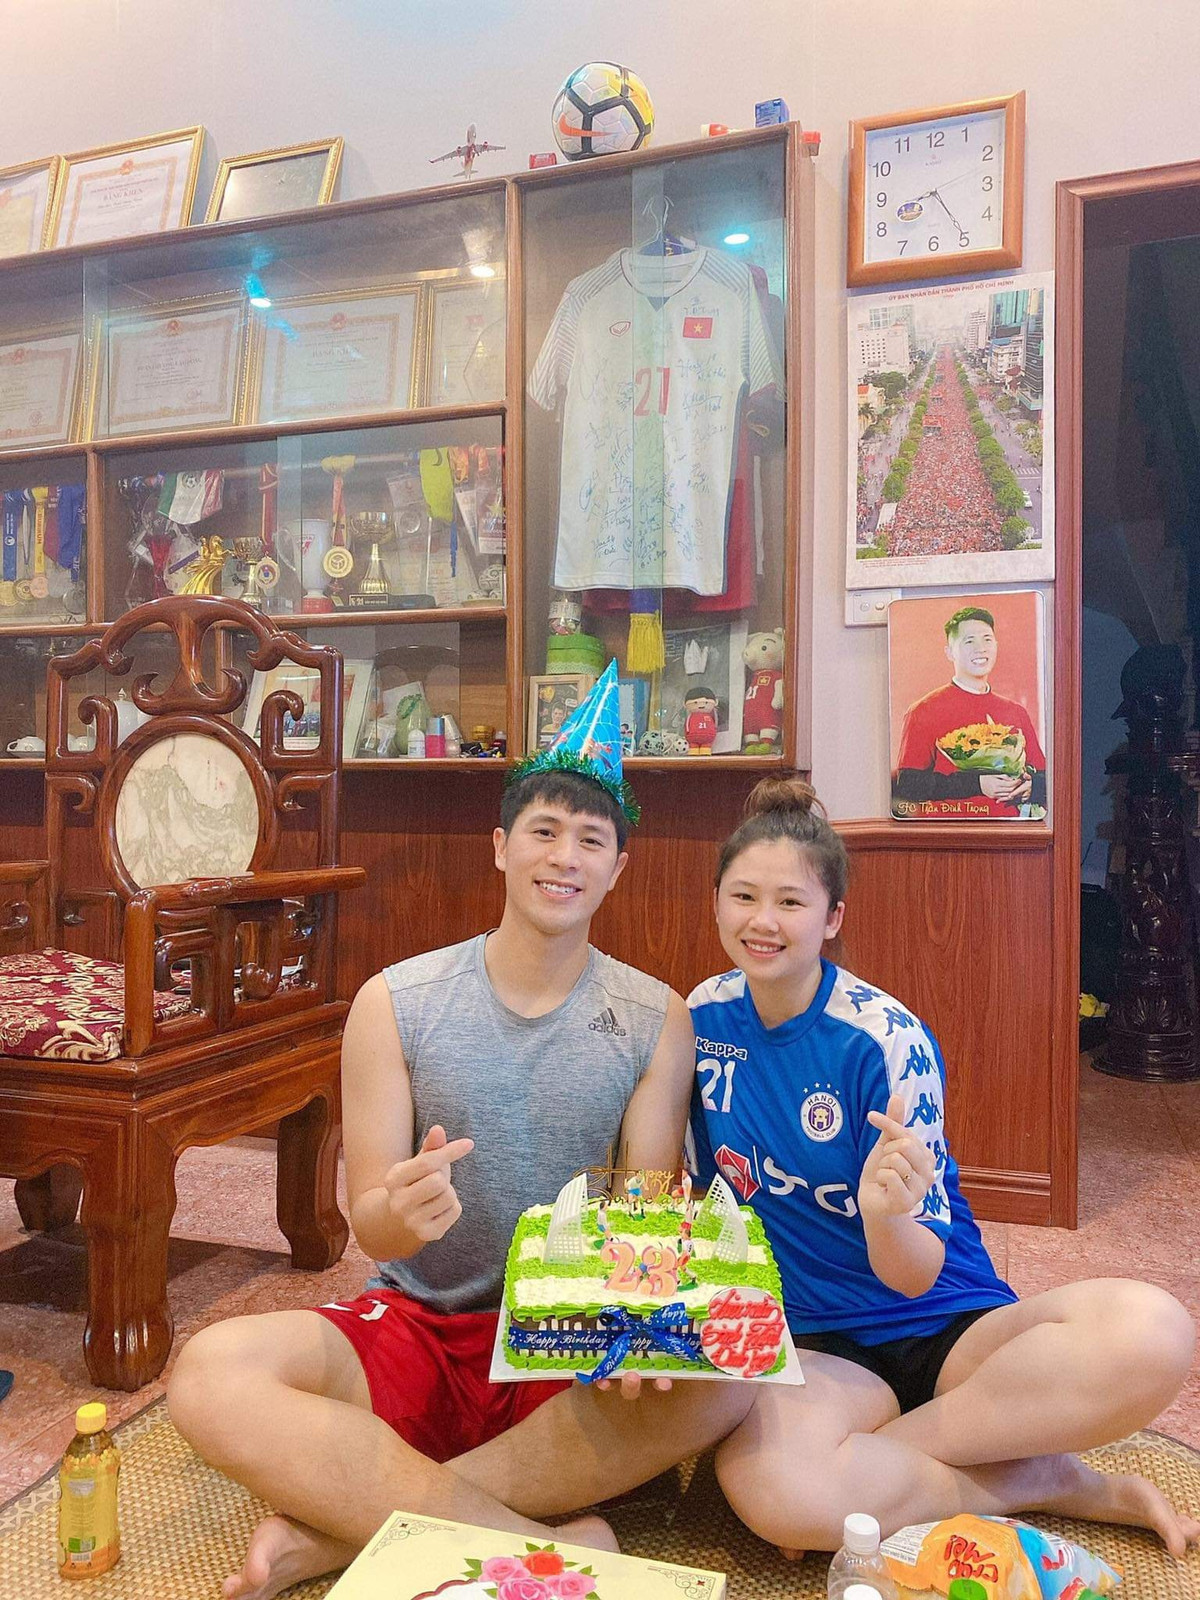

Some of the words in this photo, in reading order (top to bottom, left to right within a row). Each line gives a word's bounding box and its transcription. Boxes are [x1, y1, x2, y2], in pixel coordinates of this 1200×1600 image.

[926, 131, 945, 149] 12
[961, 126, 968, 143] 1
[895, 136, 911, 154] 11
[982, 145, 994, 162] 2
[872, 160, 891, 178] 10
[981, 175, 993, 192] 3
[876, 192, 887, 208] 9
[981, 205, 993, 221] 4
[876, 221, 887, 238] 8
[897, 240, 908, 256] 7
[928, 235, 940, 252] 6
[958, 231, 970, 248] 5
[635, 366, 670, 417] 21
[745, 685, 759, 700] 21
[588, 1022, 627, 1037] adidas
[696, 1036, 748, 1061] Kappa
[696, 1058, 736, 1113] 21
[808, 1094, 837, 1107] HANOI
[600, 1241, 677, 1298] 23
[524, 1333, 557, 1348] Happy
[560, 1334, 608, 1348] Birthday
